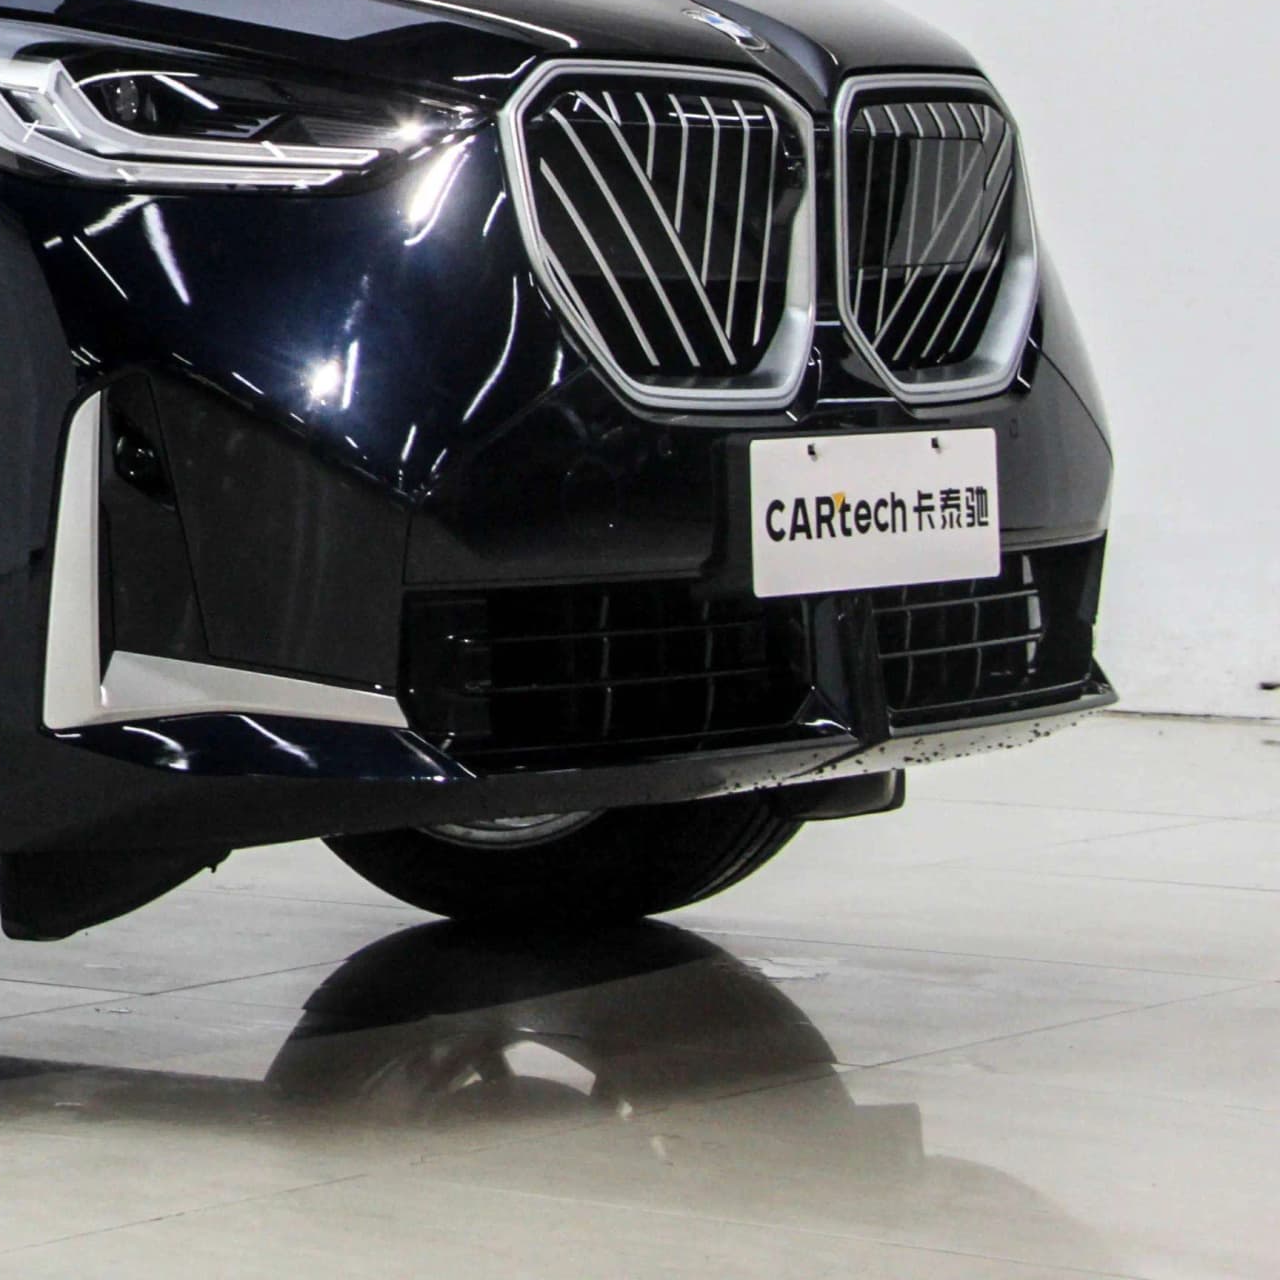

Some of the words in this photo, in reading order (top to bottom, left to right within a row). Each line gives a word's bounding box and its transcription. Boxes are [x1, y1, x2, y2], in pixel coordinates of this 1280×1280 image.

[765, 492, 907, 542] CARtech
[913, 486, 989, 531] 卡泰驰
